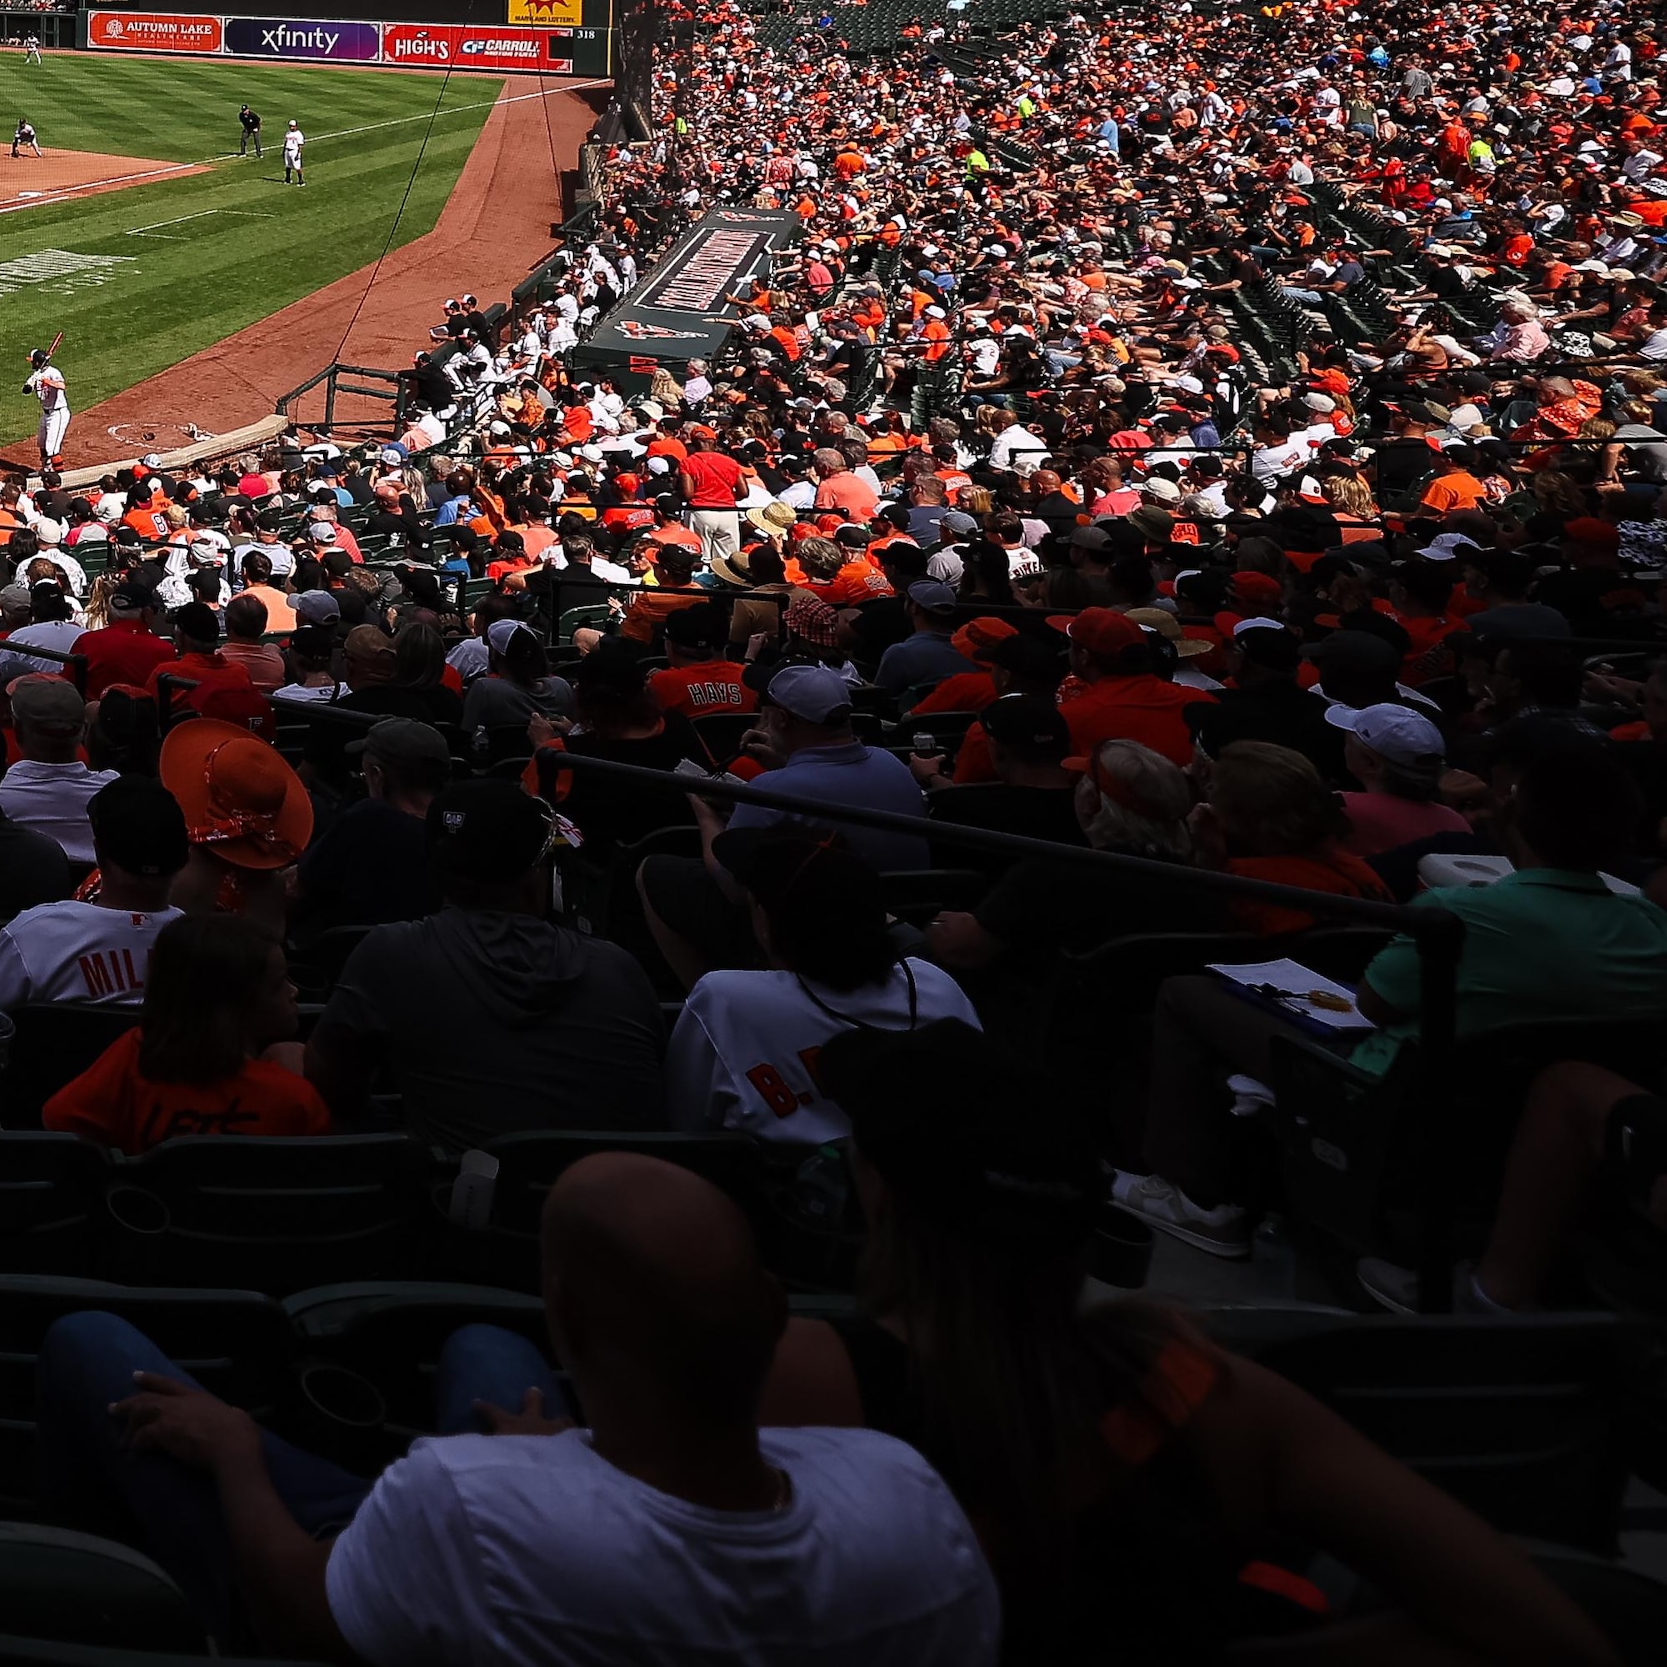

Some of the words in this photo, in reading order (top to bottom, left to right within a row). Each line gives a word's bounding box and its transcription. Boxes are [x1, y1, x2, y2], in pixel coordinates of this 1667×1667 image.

[127, 21, 177, 34] AUTUMN
[180, 23, 212, 34] LAKE
[577, 30, 596, 40] 318
[262, 24, 339, 54] xfinity
[395, 38, 449, 59] HIGH'S
[687, 682, 742, 705] HAYS
